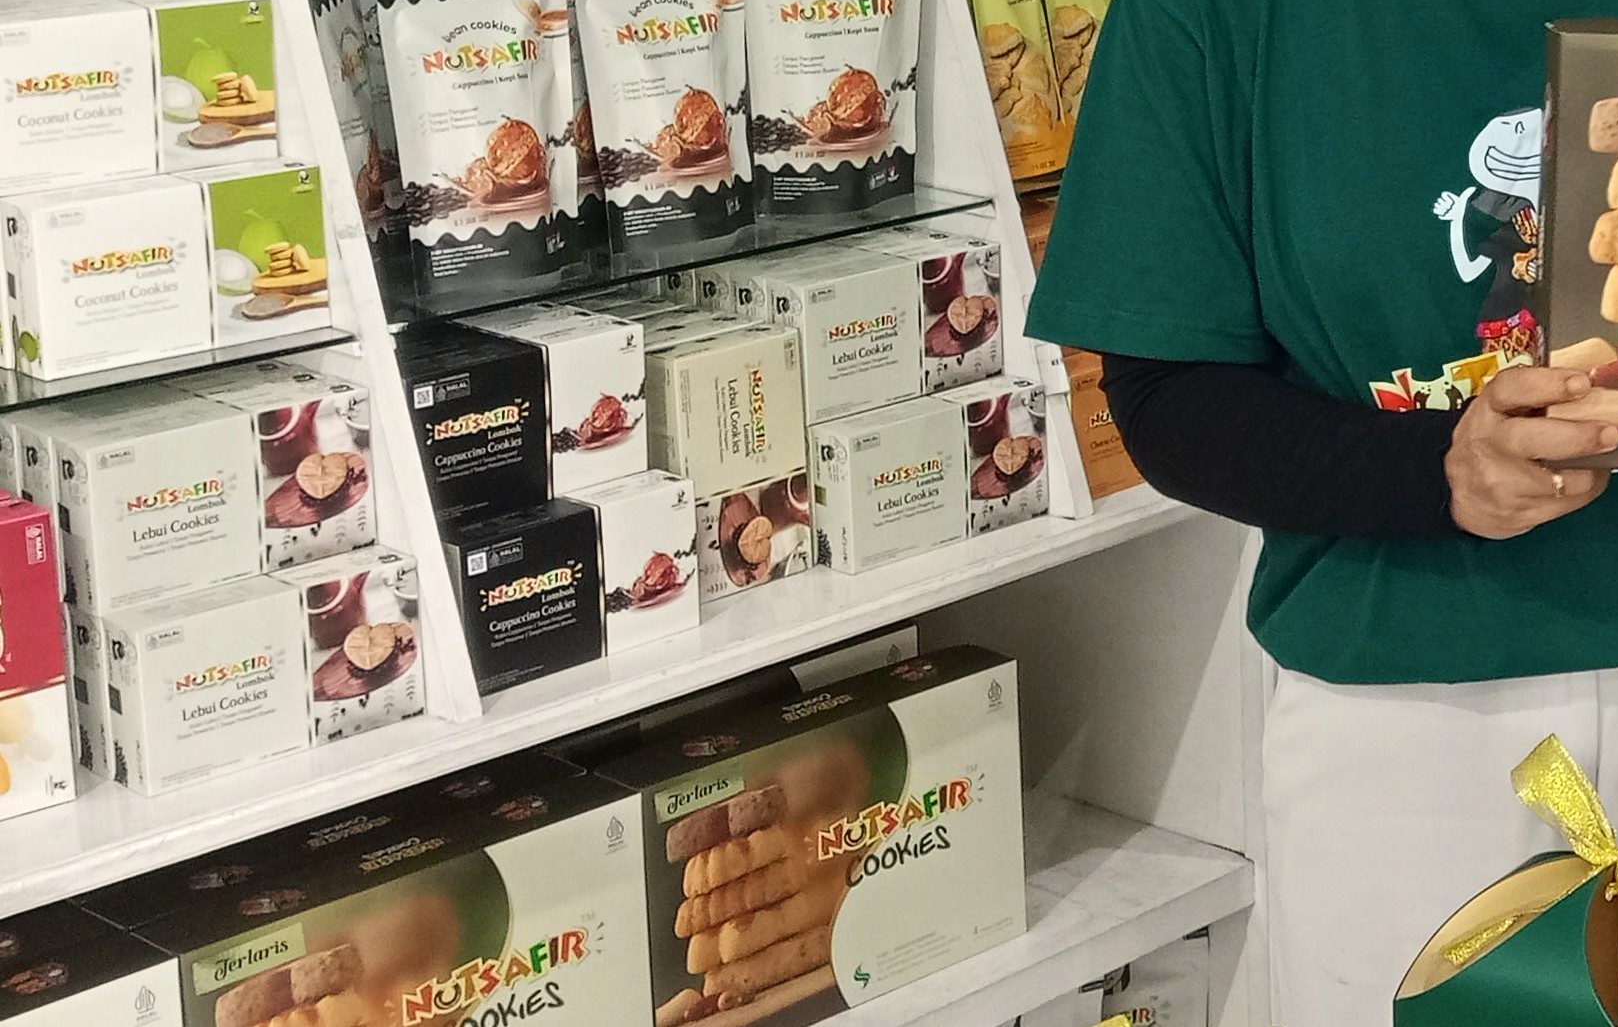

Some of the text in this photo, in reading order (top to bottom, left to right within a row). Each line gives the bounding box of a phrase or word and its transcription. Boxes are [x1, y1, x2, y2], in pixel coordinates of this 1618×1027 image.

[441, 19, 518, 45] bean cookies
[615, 11, 719, 47] NUTSAFIR
[421, 37, 540, 76] NUTSAFIR
[16, 68, 121, 97] NUTSAFIR
[17, 103, 124, 129] Coconut Cookies
[71, 242, 175, 279] NUTSAFIR
[74, 280, 180, 310] Coconut Cookies
[828, 313, 899, 343] NUTSAFIR
[831, 341, 893, 366] Lebui Cookies
[434, 403, 521, 440] NUTSAFIR
[727, 378, 742, 455] Lebui Cookies
[748, 368, 769, 453] NUTSAFIR
[434, 449, 486, 468] Cappuccino
[487, 438, 523, 455] Cookies
[873, 457, 943, 489] NUTSAFIR
[124, 476, 225, 514] NUTSAFIR
[877, 488, 940, 513] Lebui Cookies
[132, 514, 220, 544] Lebui Cookies
[486, 567, 574, 607] NUTSAFIR
[489, 599, 577, 633] Cappuccino Cookies
[174, 653, 271, 693] NUTSAFIR
[181, 690, 269, 721] Lebui Cookies
[816, 776, 976, 861] NUTSAFIR
[846, 825, 952, 889] COOKIES
[400, 925, 592, 1027] NUTSAFIR
